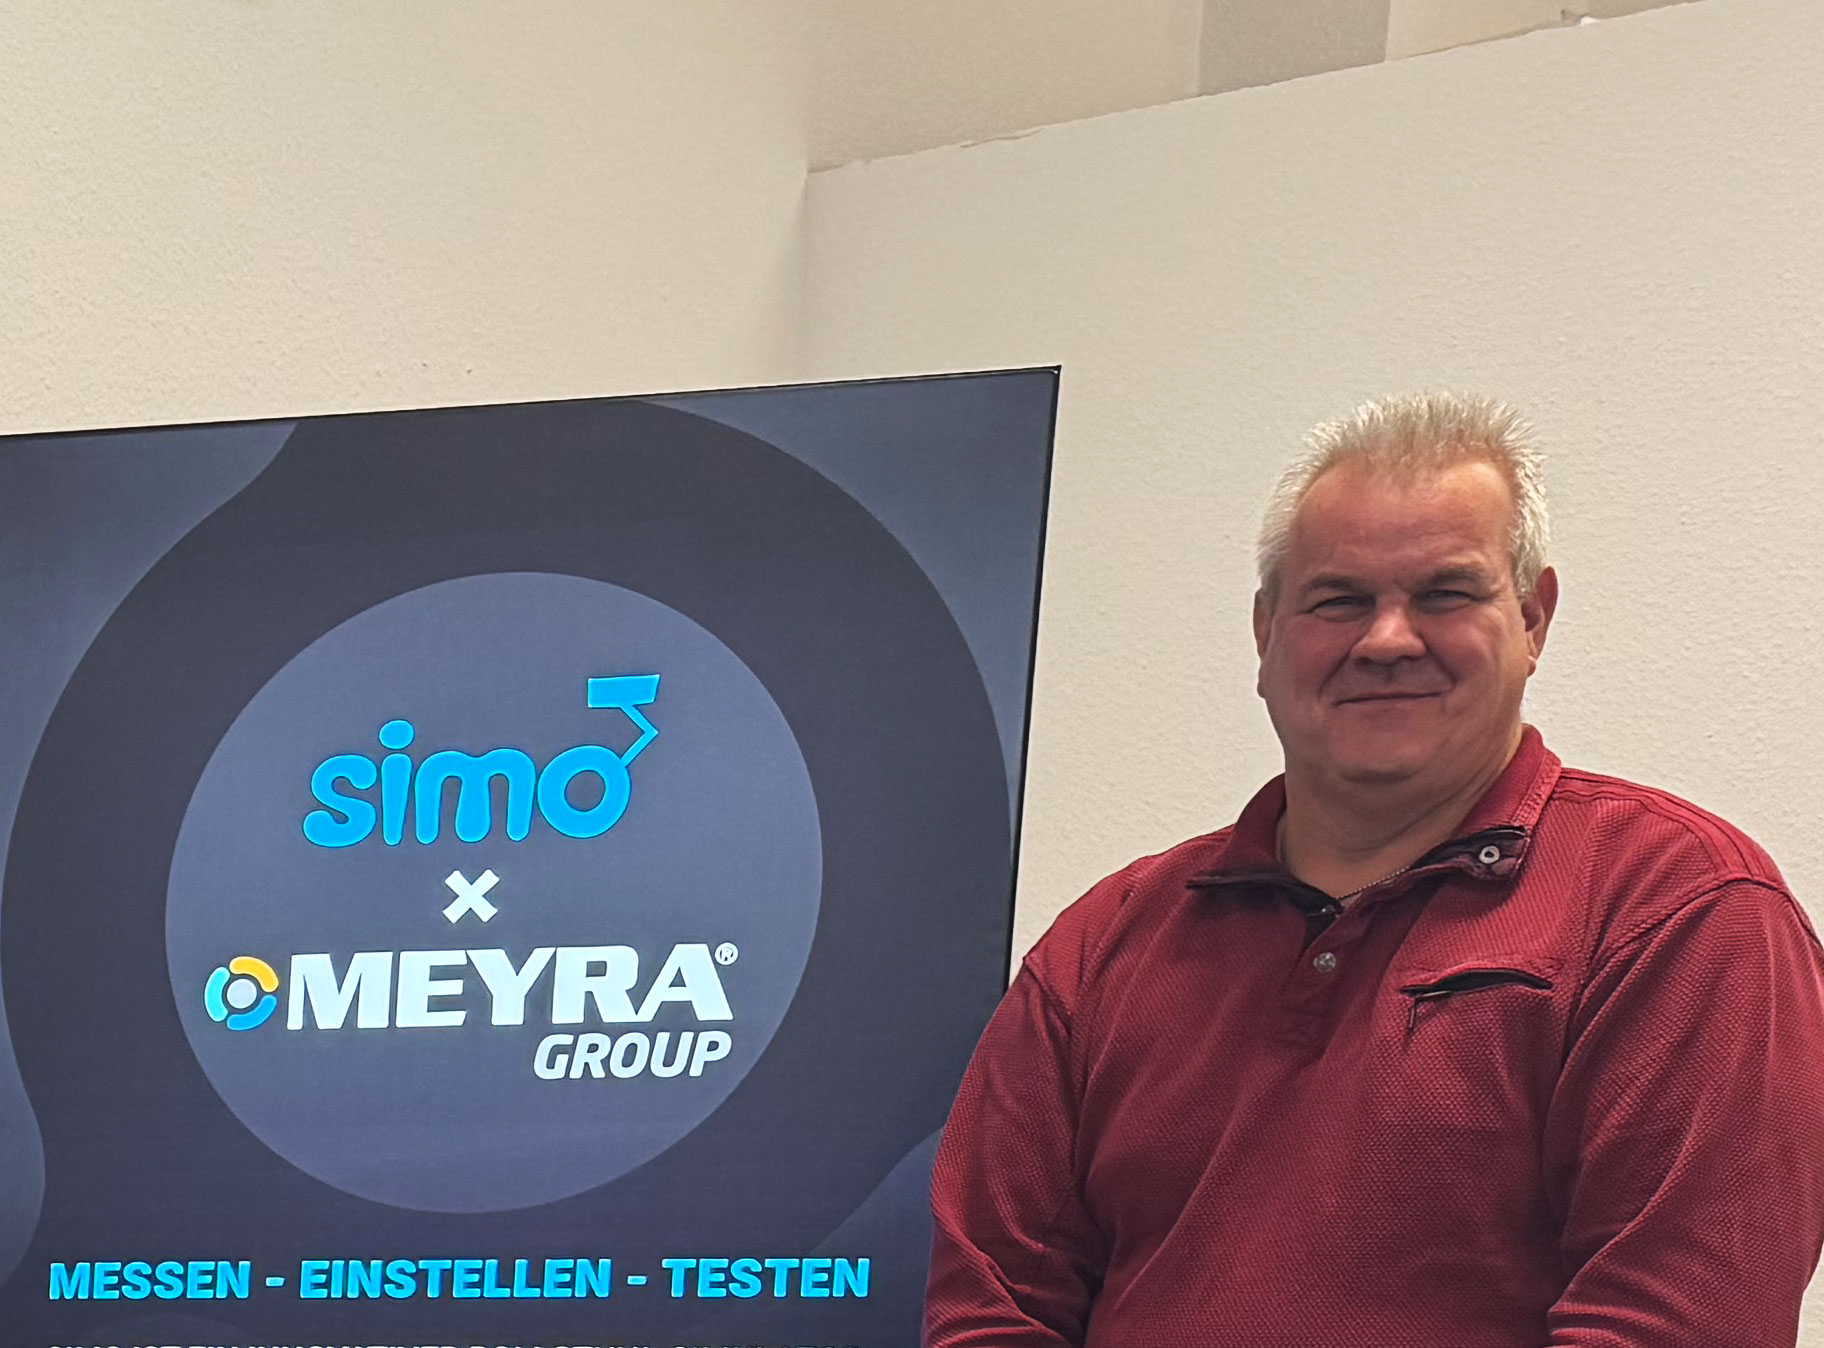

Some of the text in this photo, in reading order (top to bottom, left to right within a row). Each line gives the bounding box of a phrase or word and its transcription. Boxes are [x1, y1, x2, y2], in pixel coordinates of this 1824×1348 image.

[302, 674, 660, 849] simo
[533, 1031, 732, 1080] GROUP
[48, 1260, 252, 1301] MESSEN
[299, 1258, 613, 1301] EINSTELLEN
[661, 1257, 871, 1300] TESTEN
